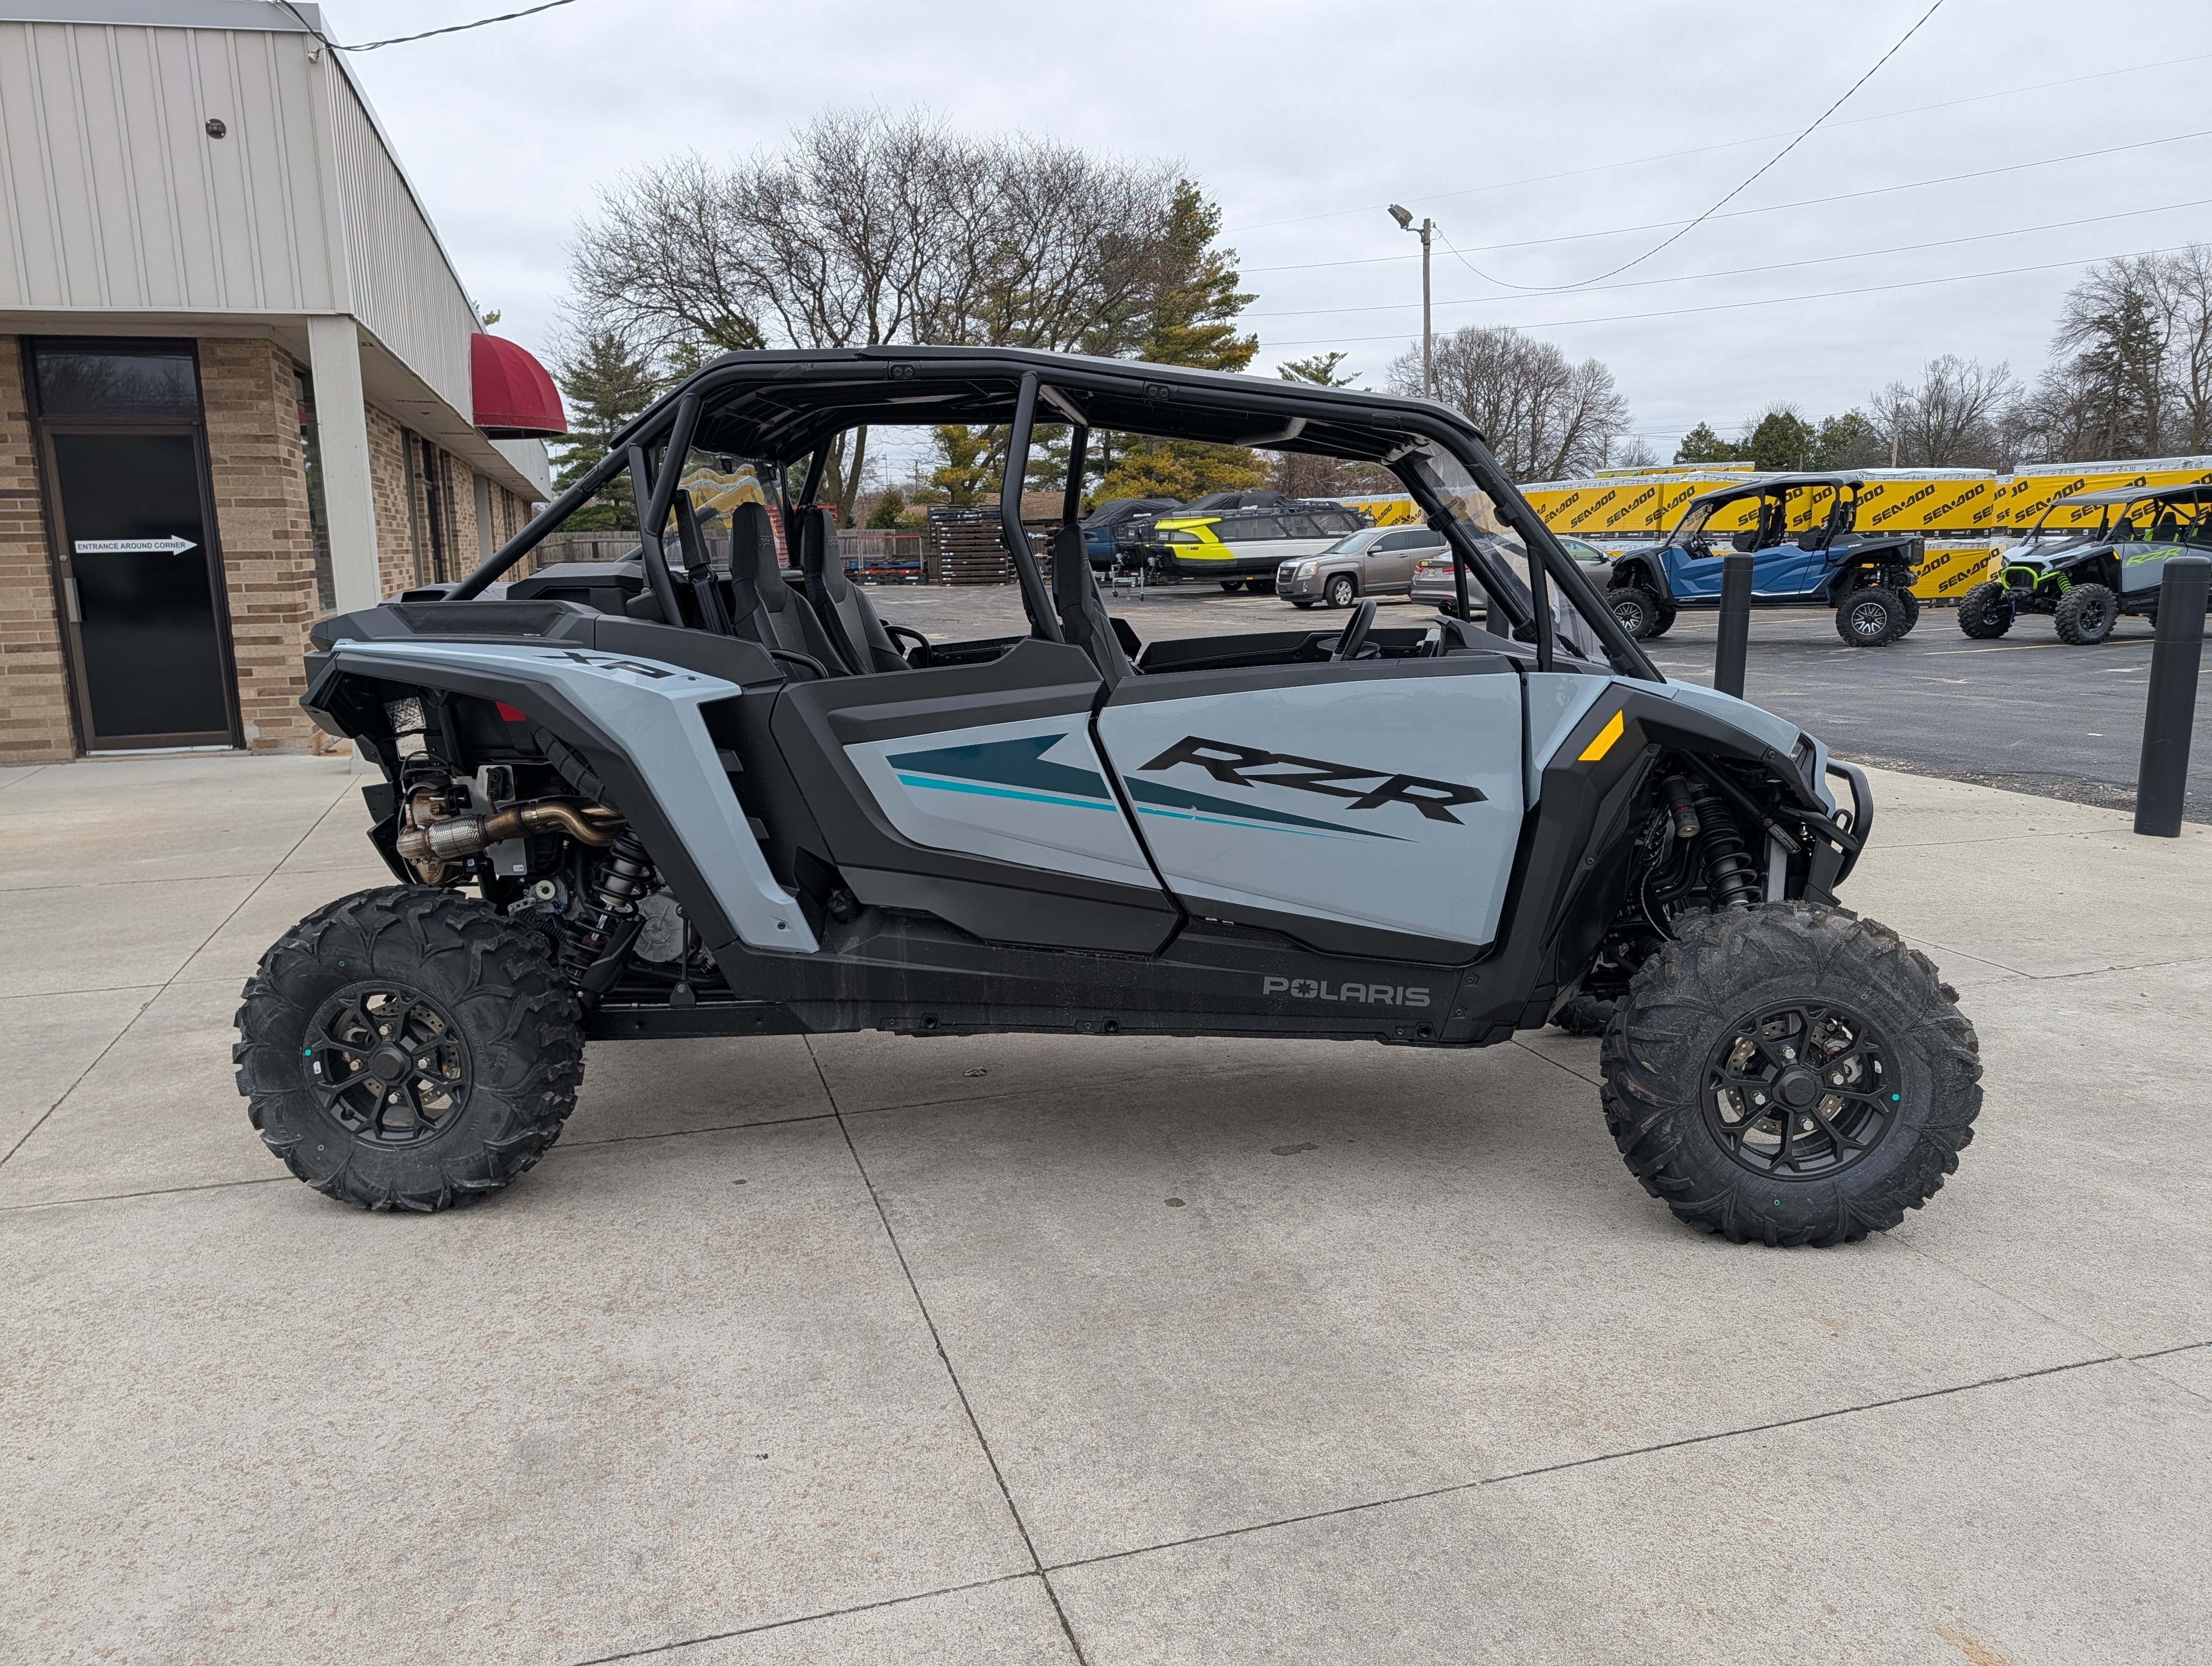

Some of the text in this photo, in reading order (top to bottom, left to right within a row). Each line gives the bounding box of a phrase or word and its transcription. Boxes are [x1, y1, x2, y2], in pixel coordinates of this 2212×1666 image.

[2126, 547, 2183, 567] RZR
[2128, 598, 2155, 606] POLARIS
[533, 651, 677, 679] XP
[1136, 735, 1489, 825] RZR
[1263, 976, 1430, 1007] POLARIS
